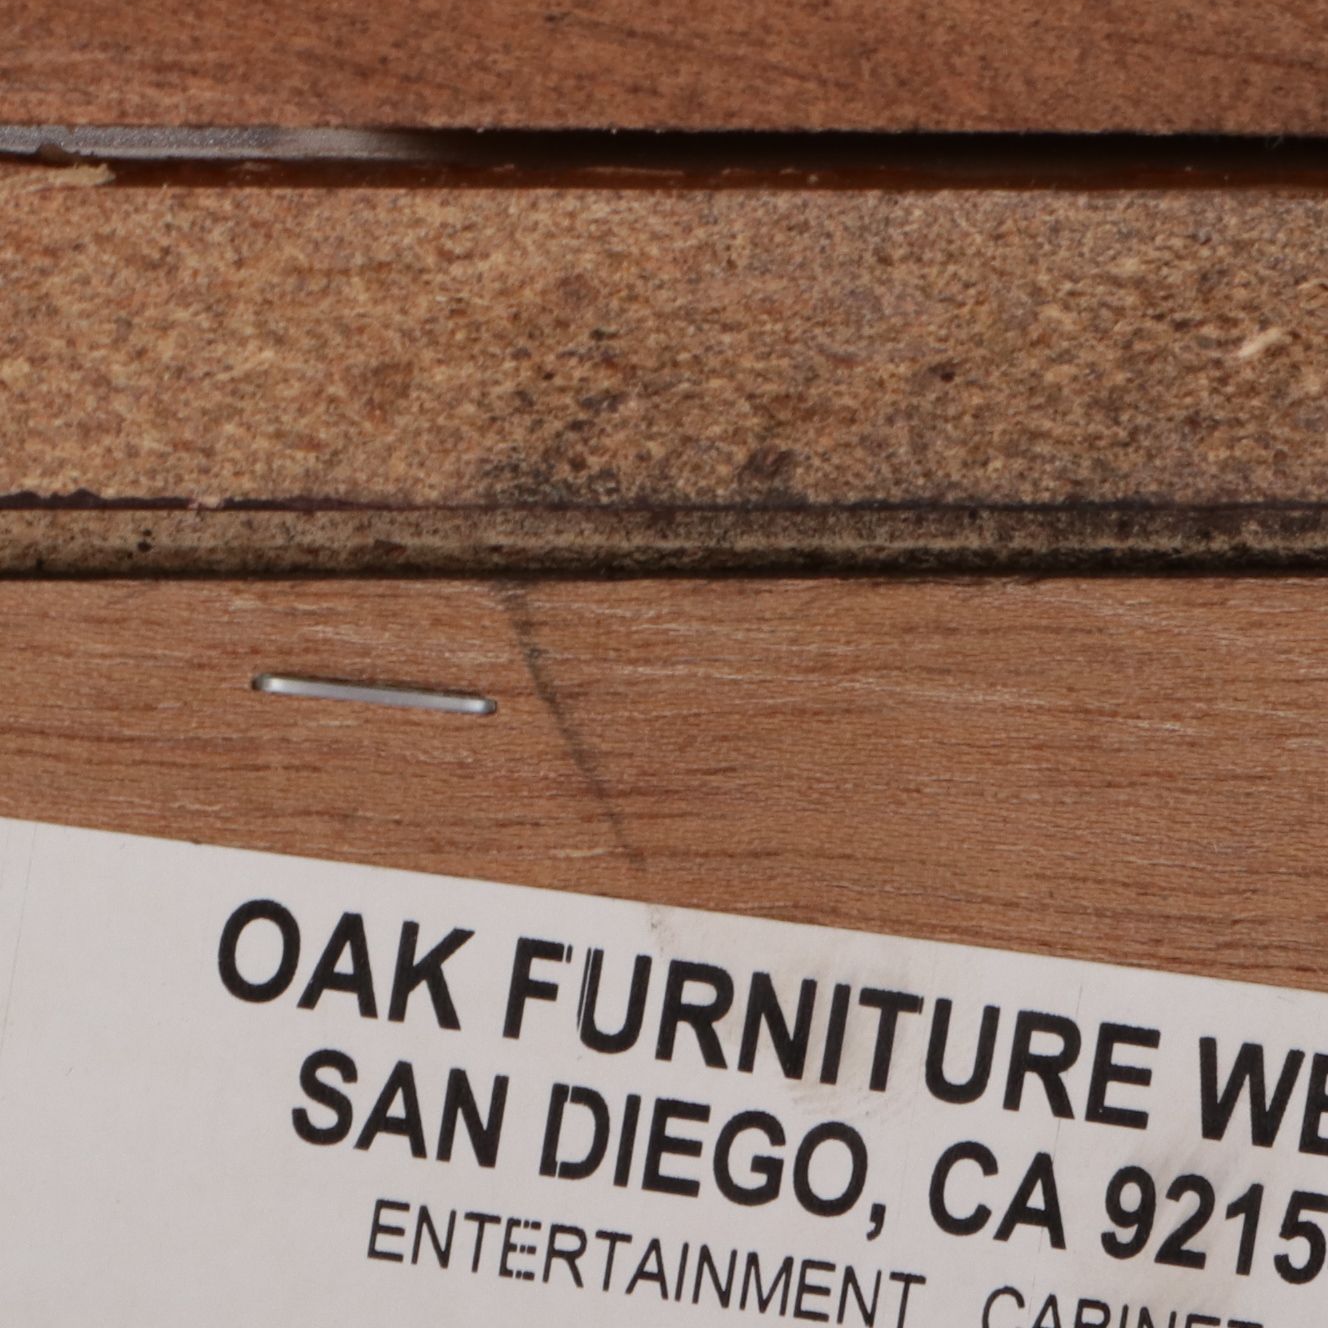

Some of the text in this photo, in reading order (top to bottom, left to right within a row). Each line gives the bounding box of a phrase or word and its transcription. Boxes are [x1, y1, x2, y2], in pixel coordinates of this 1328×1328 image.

[218, 898, 475, 1031] OAK
[502, 936, 1162, 1130] FURNITURE
[291, 1048, 510, 1170] SAN
[539, 1082, 887, 1241] DIEGO,
[928, 1140, 1068, 1251] CA
[366, 1197, 928, 1328] ENTERTAINMENT
